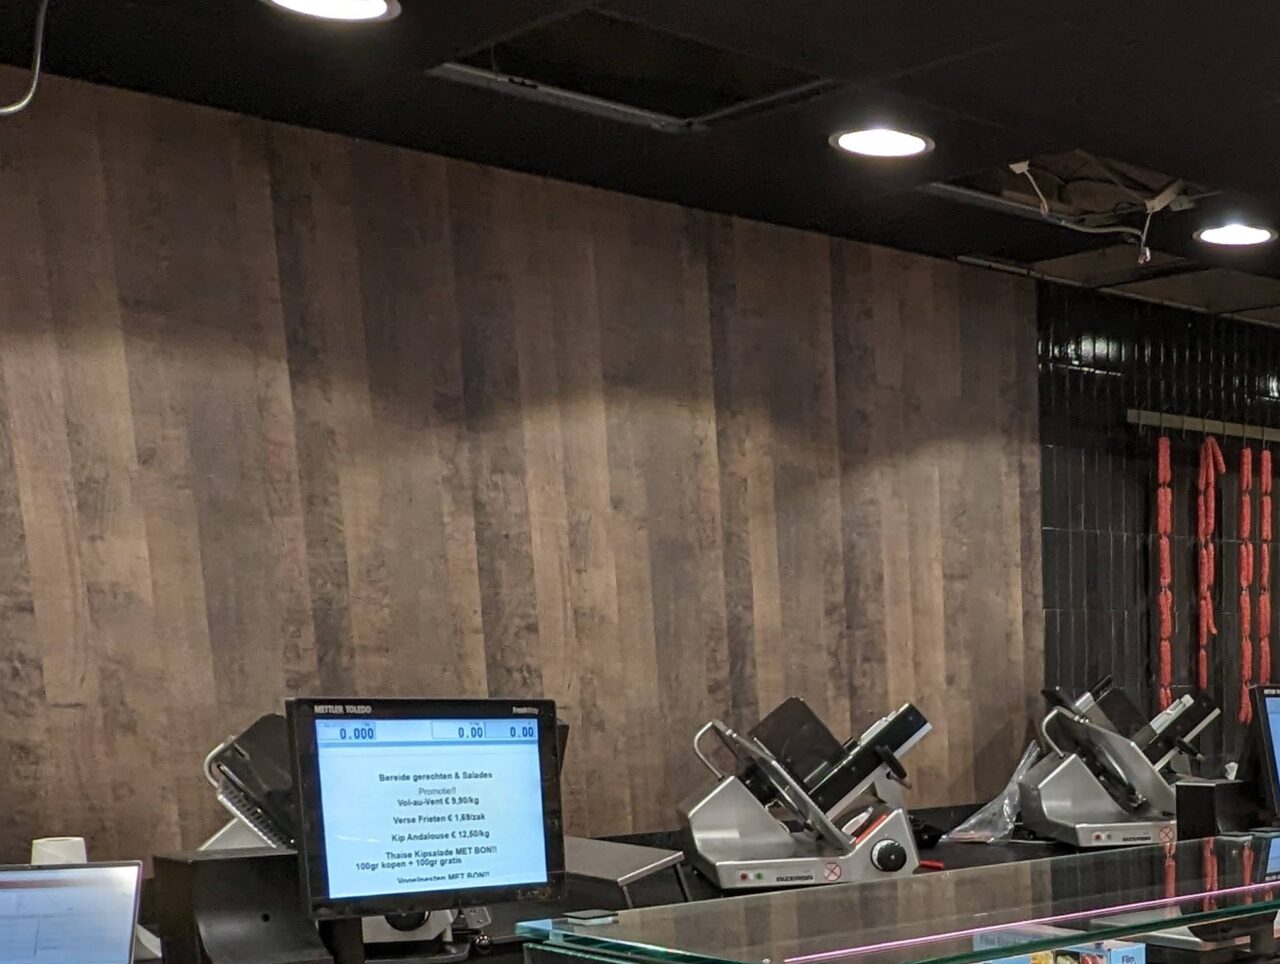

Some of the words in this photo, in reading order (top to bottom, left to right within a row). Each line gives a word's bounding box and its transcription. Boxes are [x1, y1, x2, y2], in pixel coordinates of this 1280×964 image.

[346, 705, 372, 714] TOLEDO
[340, 728, 374, 740] 0.000
[458, 727, 483, 738] 0.00
[510, 726, 534, 737] 0.00
[378, 773, 411, 782] Bereide
[413, 773, 452, 783] gerechten
[462, 771, 493, 779] Salades
[397, 797, 443, 807] Vol-au-Vent
[393, 816, 416, 824] Verse
[418, 815, 446, 824] Frieten
[391, 834, 406, 843] Kip
[407, 832, 449, 841] Andalouse
[385, 851, 413, 860] Thaise
[414, 849, 453, 859] Kipsalade
[455, 847, 472, 855] MET
[355, 862, 379, 872] 100gr
[381, 861, 406, 870] kopen
[439, 857, 462, 867] gratis
